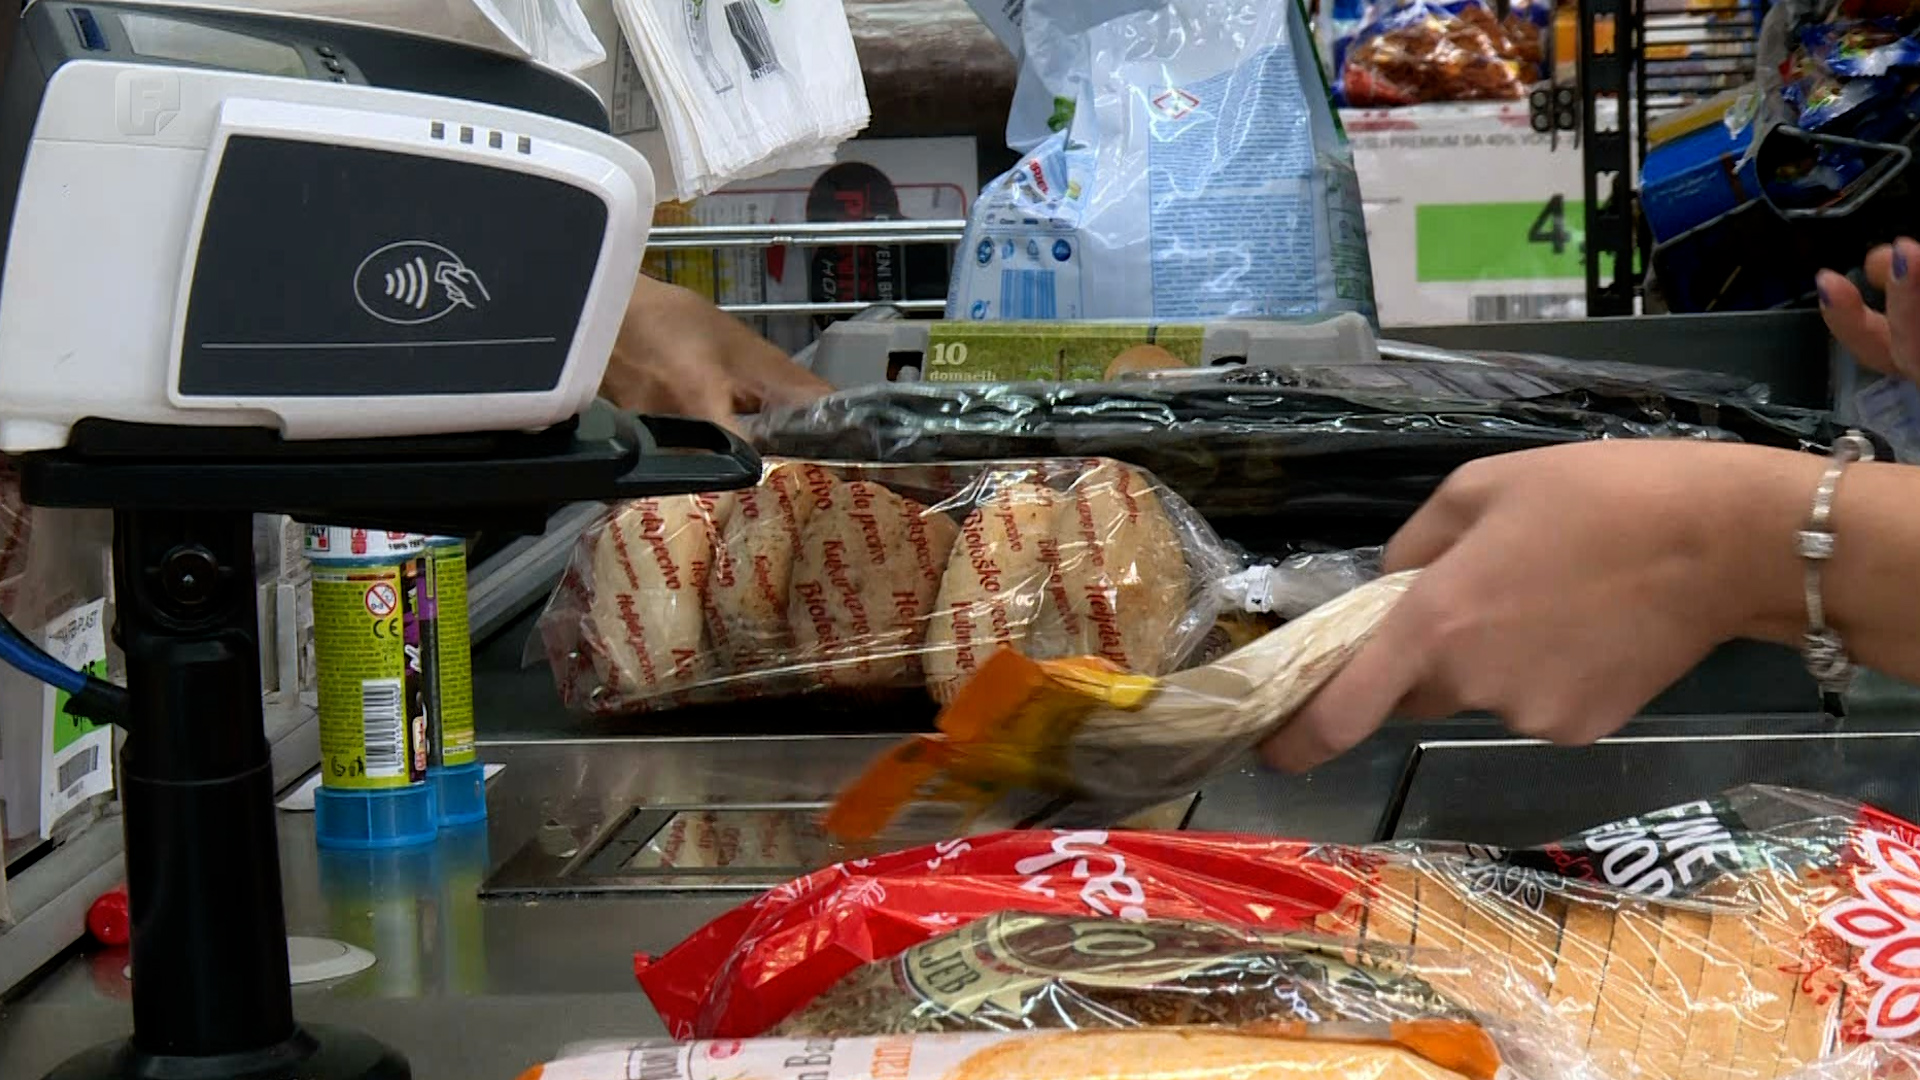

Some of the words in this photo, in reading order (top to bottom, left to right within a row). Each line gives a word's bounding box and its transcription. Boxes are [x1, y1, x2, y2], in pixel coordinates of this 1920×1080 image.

[930, 343, 969, 366] 10
[963, 508, 1002, 593] Biološko
[918, 929, 981, 995] LJEB
